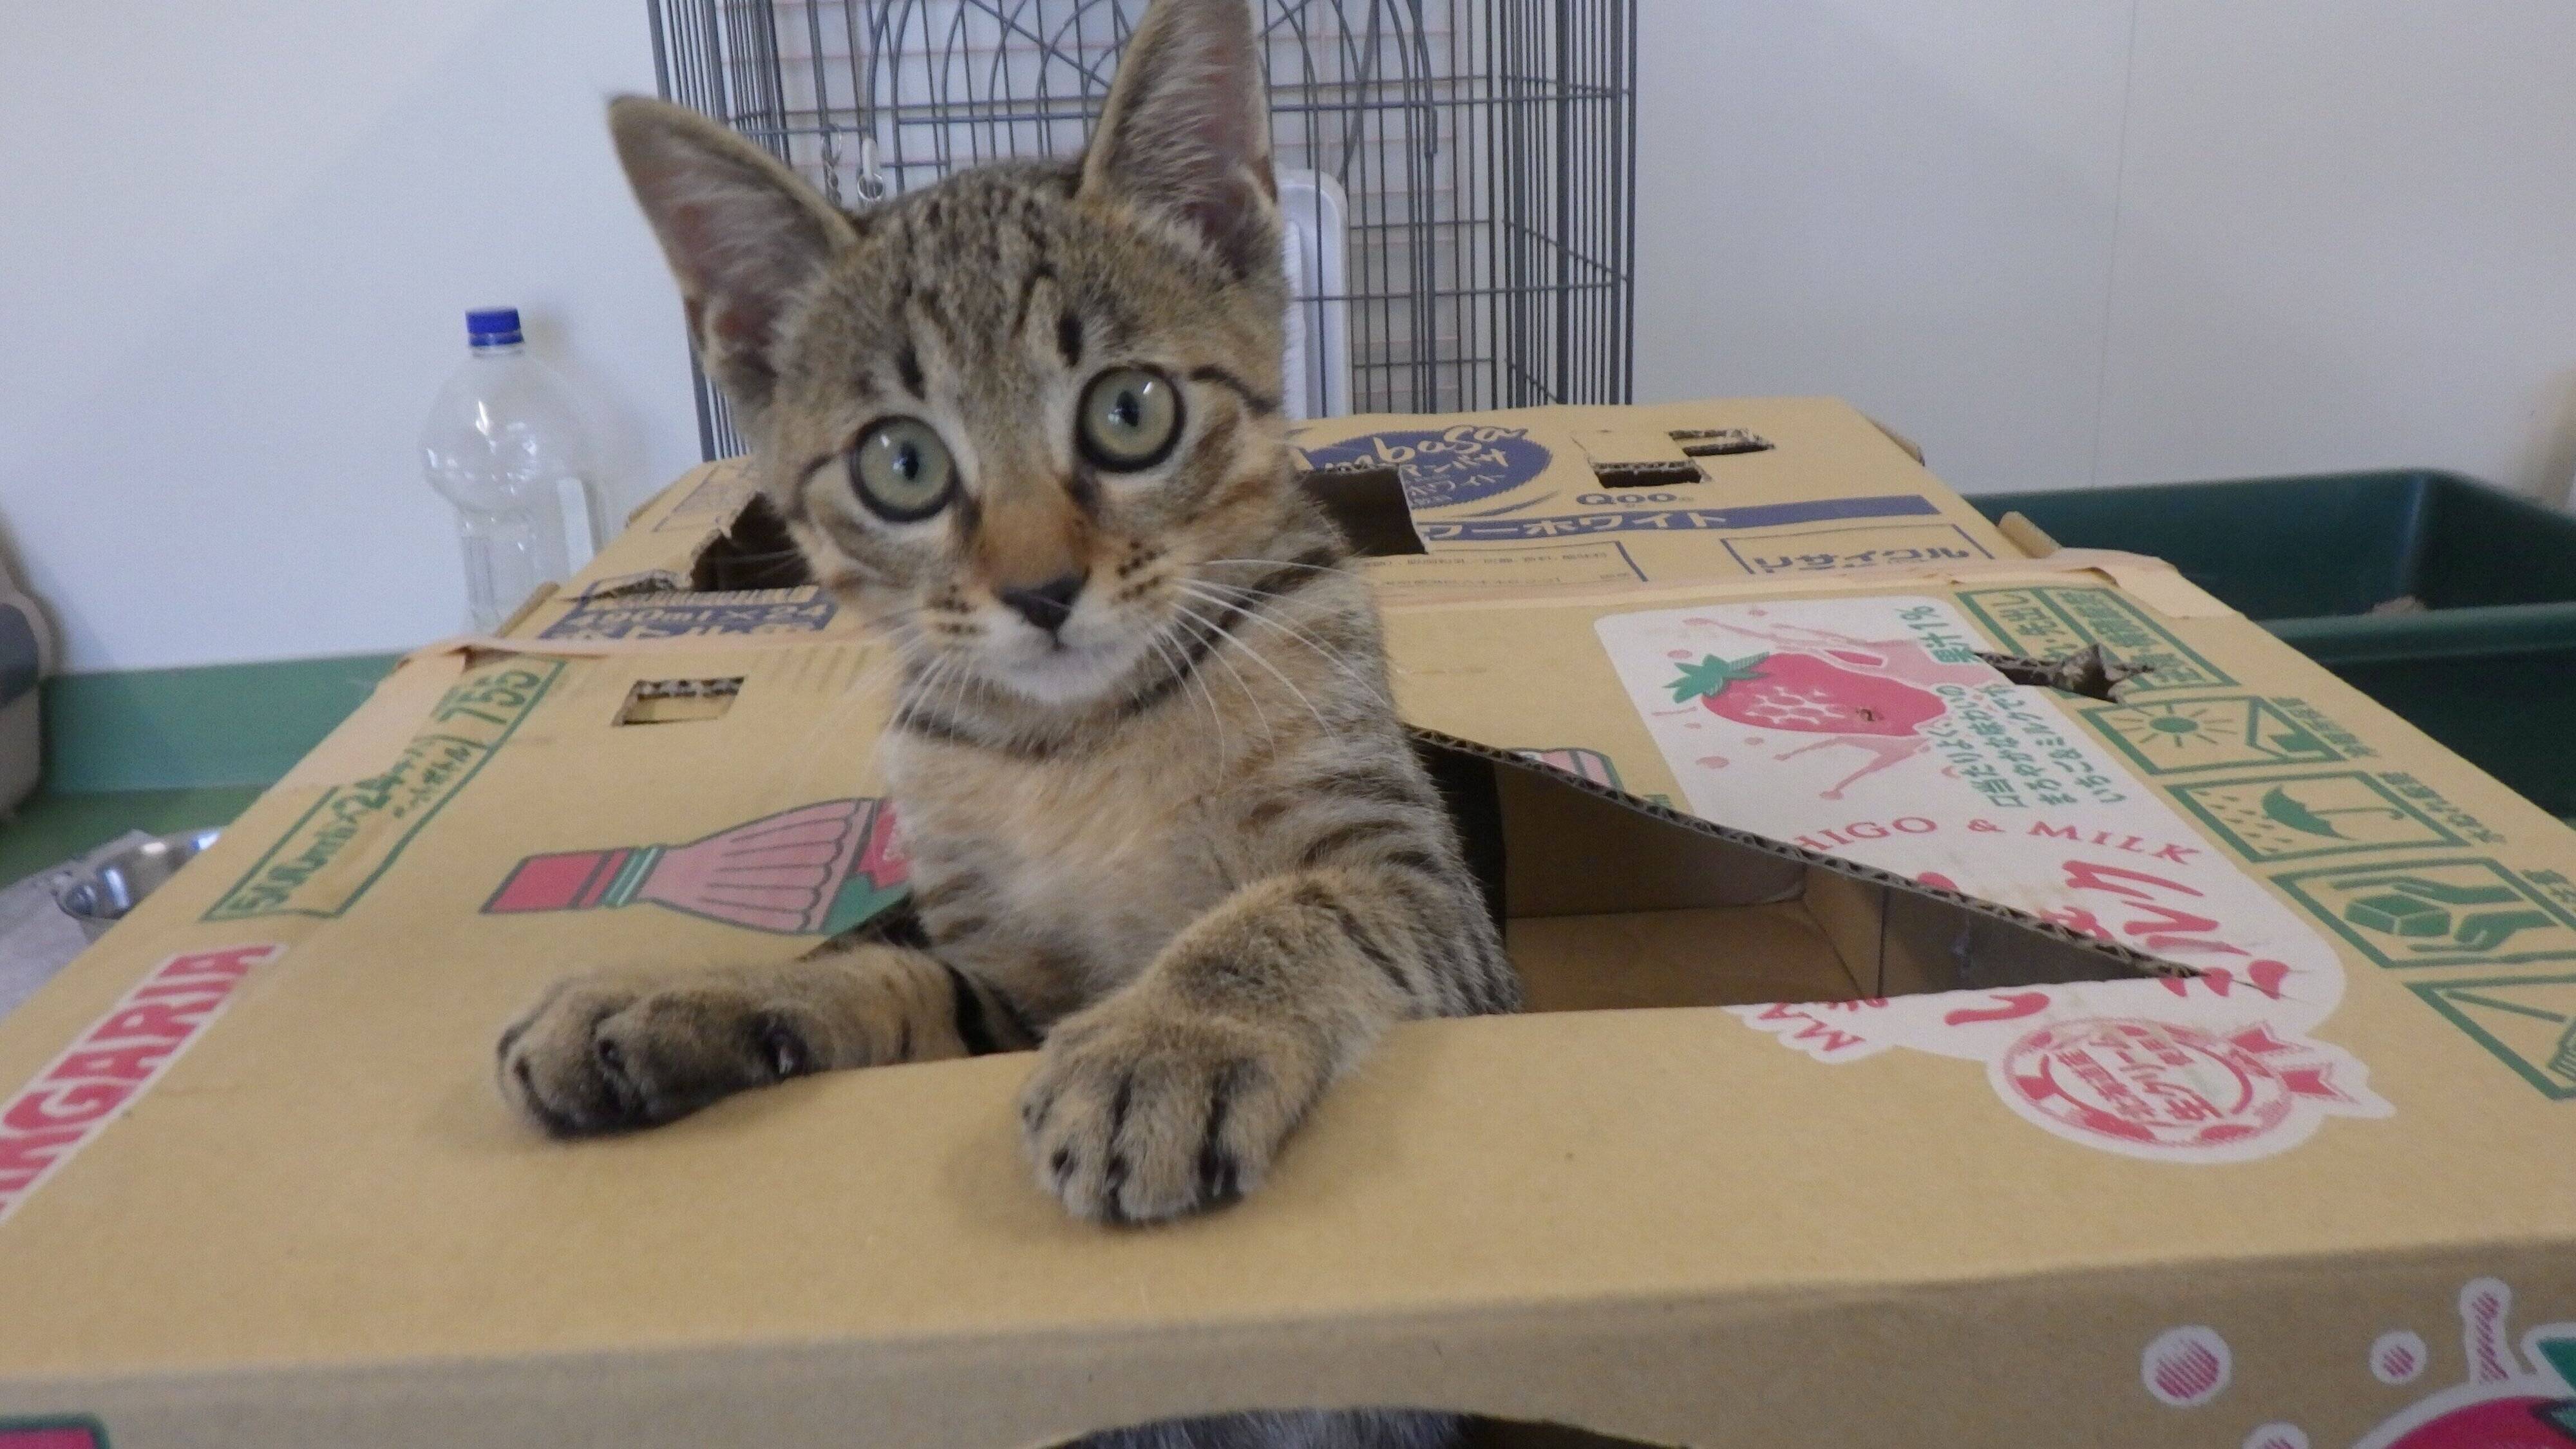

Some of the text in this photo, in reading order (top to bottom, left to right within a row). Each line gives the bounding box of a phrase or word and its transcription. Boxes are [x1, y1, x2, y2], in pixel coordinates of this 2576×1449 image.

[1419, 511, 1727, 540] ワーホワイト
[2027, 820, 2201, 865] MILK
[0, 944, 278, 1214] NGARIA
